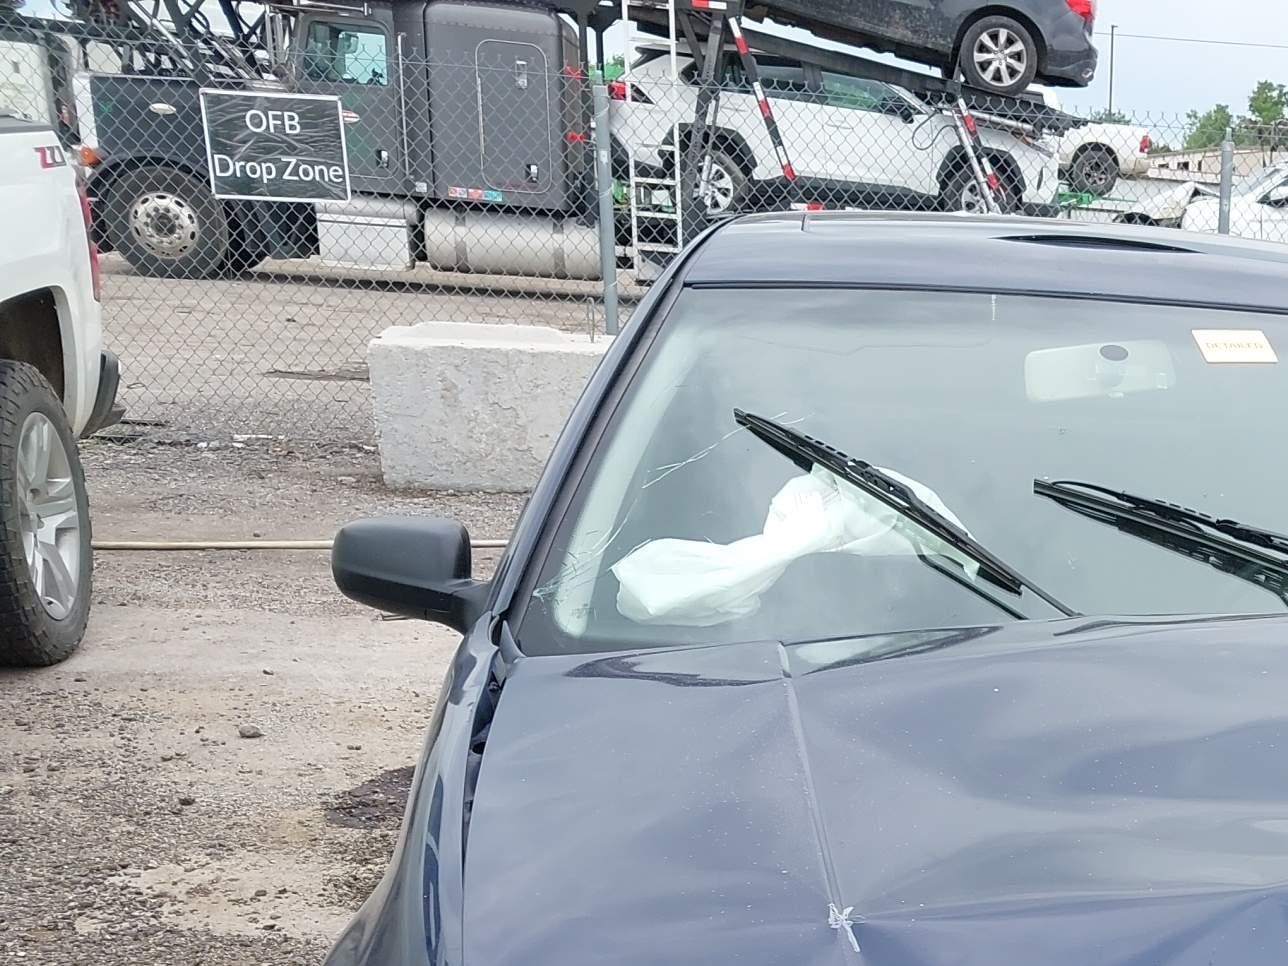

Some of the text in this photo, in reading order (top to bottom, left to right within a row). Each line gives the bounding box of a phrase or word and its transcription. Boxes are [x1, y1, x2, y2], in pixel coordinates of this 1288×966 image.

[245, 109, 302, 134] OFB
[213, 154, 345, 184] Drop Zone
